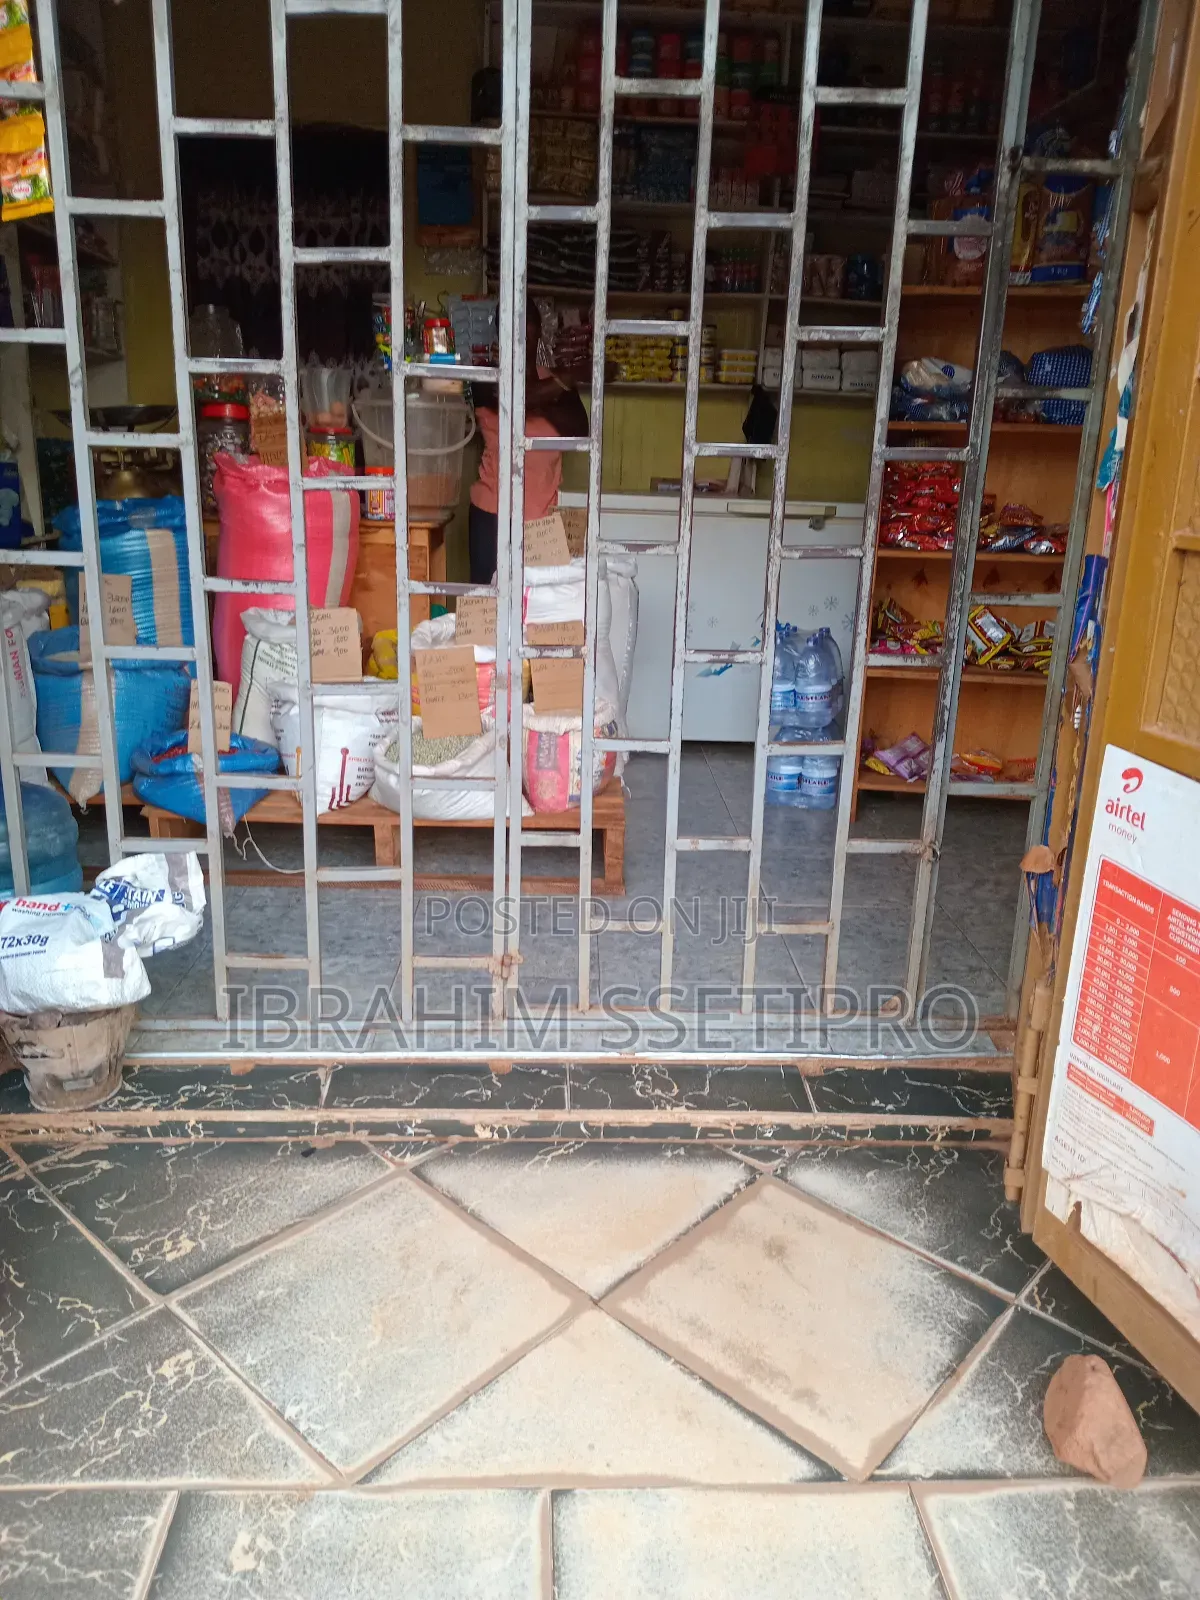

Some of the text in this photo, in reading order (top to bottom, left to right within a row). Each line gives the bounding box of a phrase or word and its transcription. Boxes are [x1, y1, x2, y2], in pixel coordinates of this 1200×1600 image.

[1105, 798, 1146, 830] airtel
[1108, 822, 1137, 844] money
[1102, 878, 1154, 915] TRANSACTION BANDS
[1168, 914, 1186, 930] AIRTEL
[1172, 908, 1197, 928] SENDING
[0, 934, 49, 949] 72x30g
